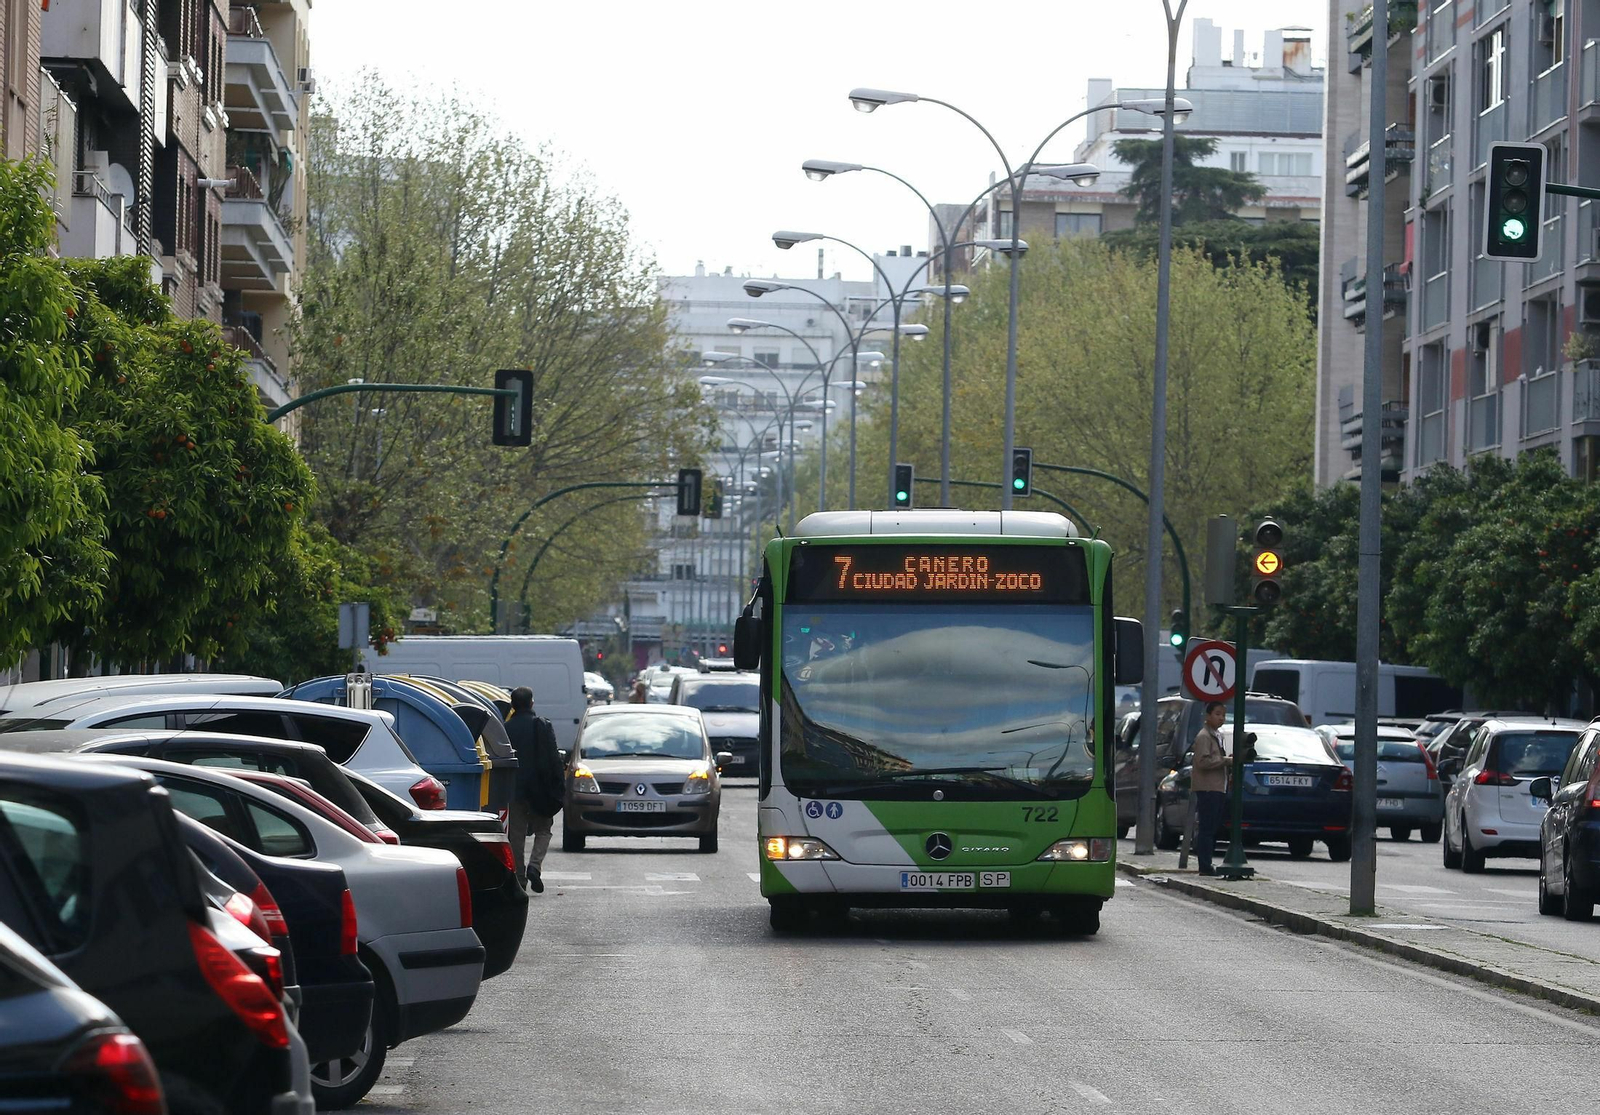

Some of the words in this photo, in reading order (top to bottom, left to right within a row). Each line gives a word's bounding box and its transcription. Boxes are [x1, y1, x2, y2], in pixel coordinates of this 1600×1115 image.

[834, 556, 852, 589] 7
[853, 573, 918, 589] CIUDAD
[1269, 776, 1291, 785] 6514
[1292, 777, 1309, 786] FKY
[623, 802, 645, 811] 1059
[646, 802, 664, 811] DFT
[1021, 806, 1059, 823] 722
[909, 874, 944, 887] 0014
[948, 874, 973, 887] FPB
